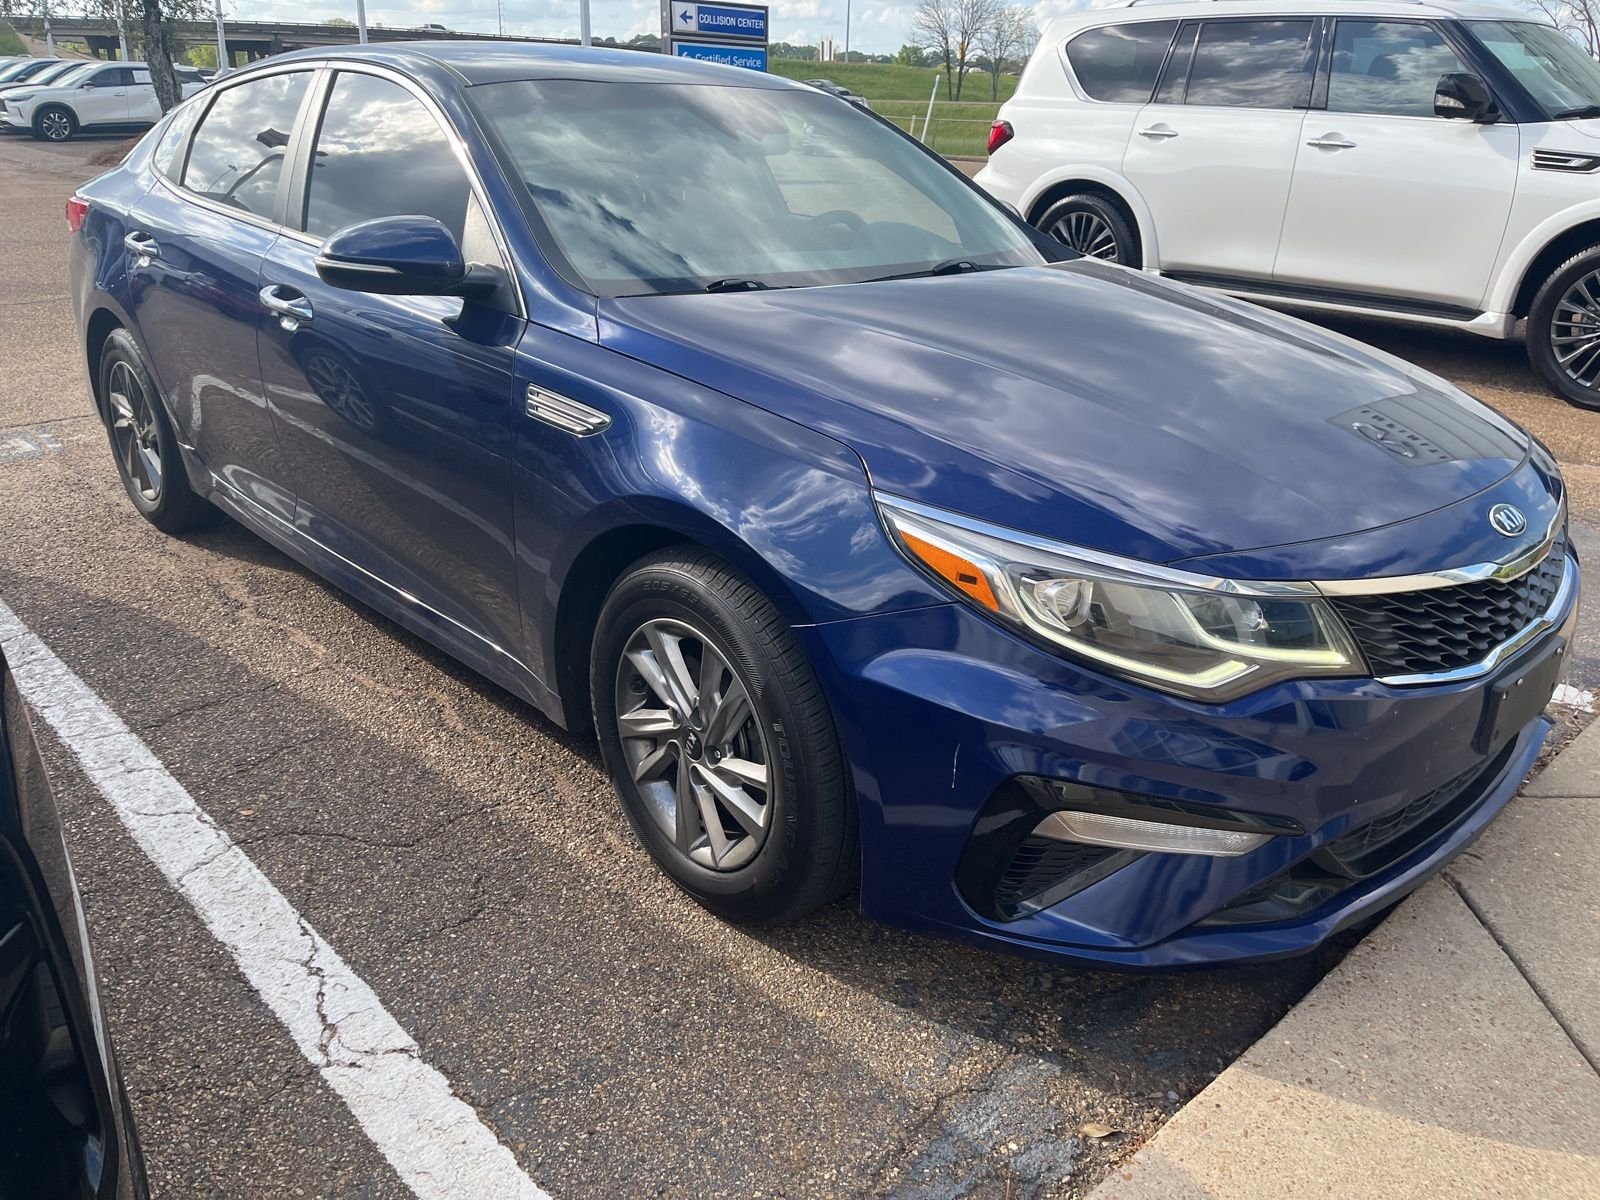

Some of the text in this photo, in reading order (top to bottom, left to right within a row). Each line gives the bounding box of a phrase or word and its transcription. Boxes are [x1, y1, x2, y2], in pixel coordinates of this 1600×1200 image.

[699, 14, 764, 29] COLLISION CENTER
[732, 55, 762, 68] Service
[1494, 506, 1525, 531] KIA
[685, 731, 697, 755] KIA
